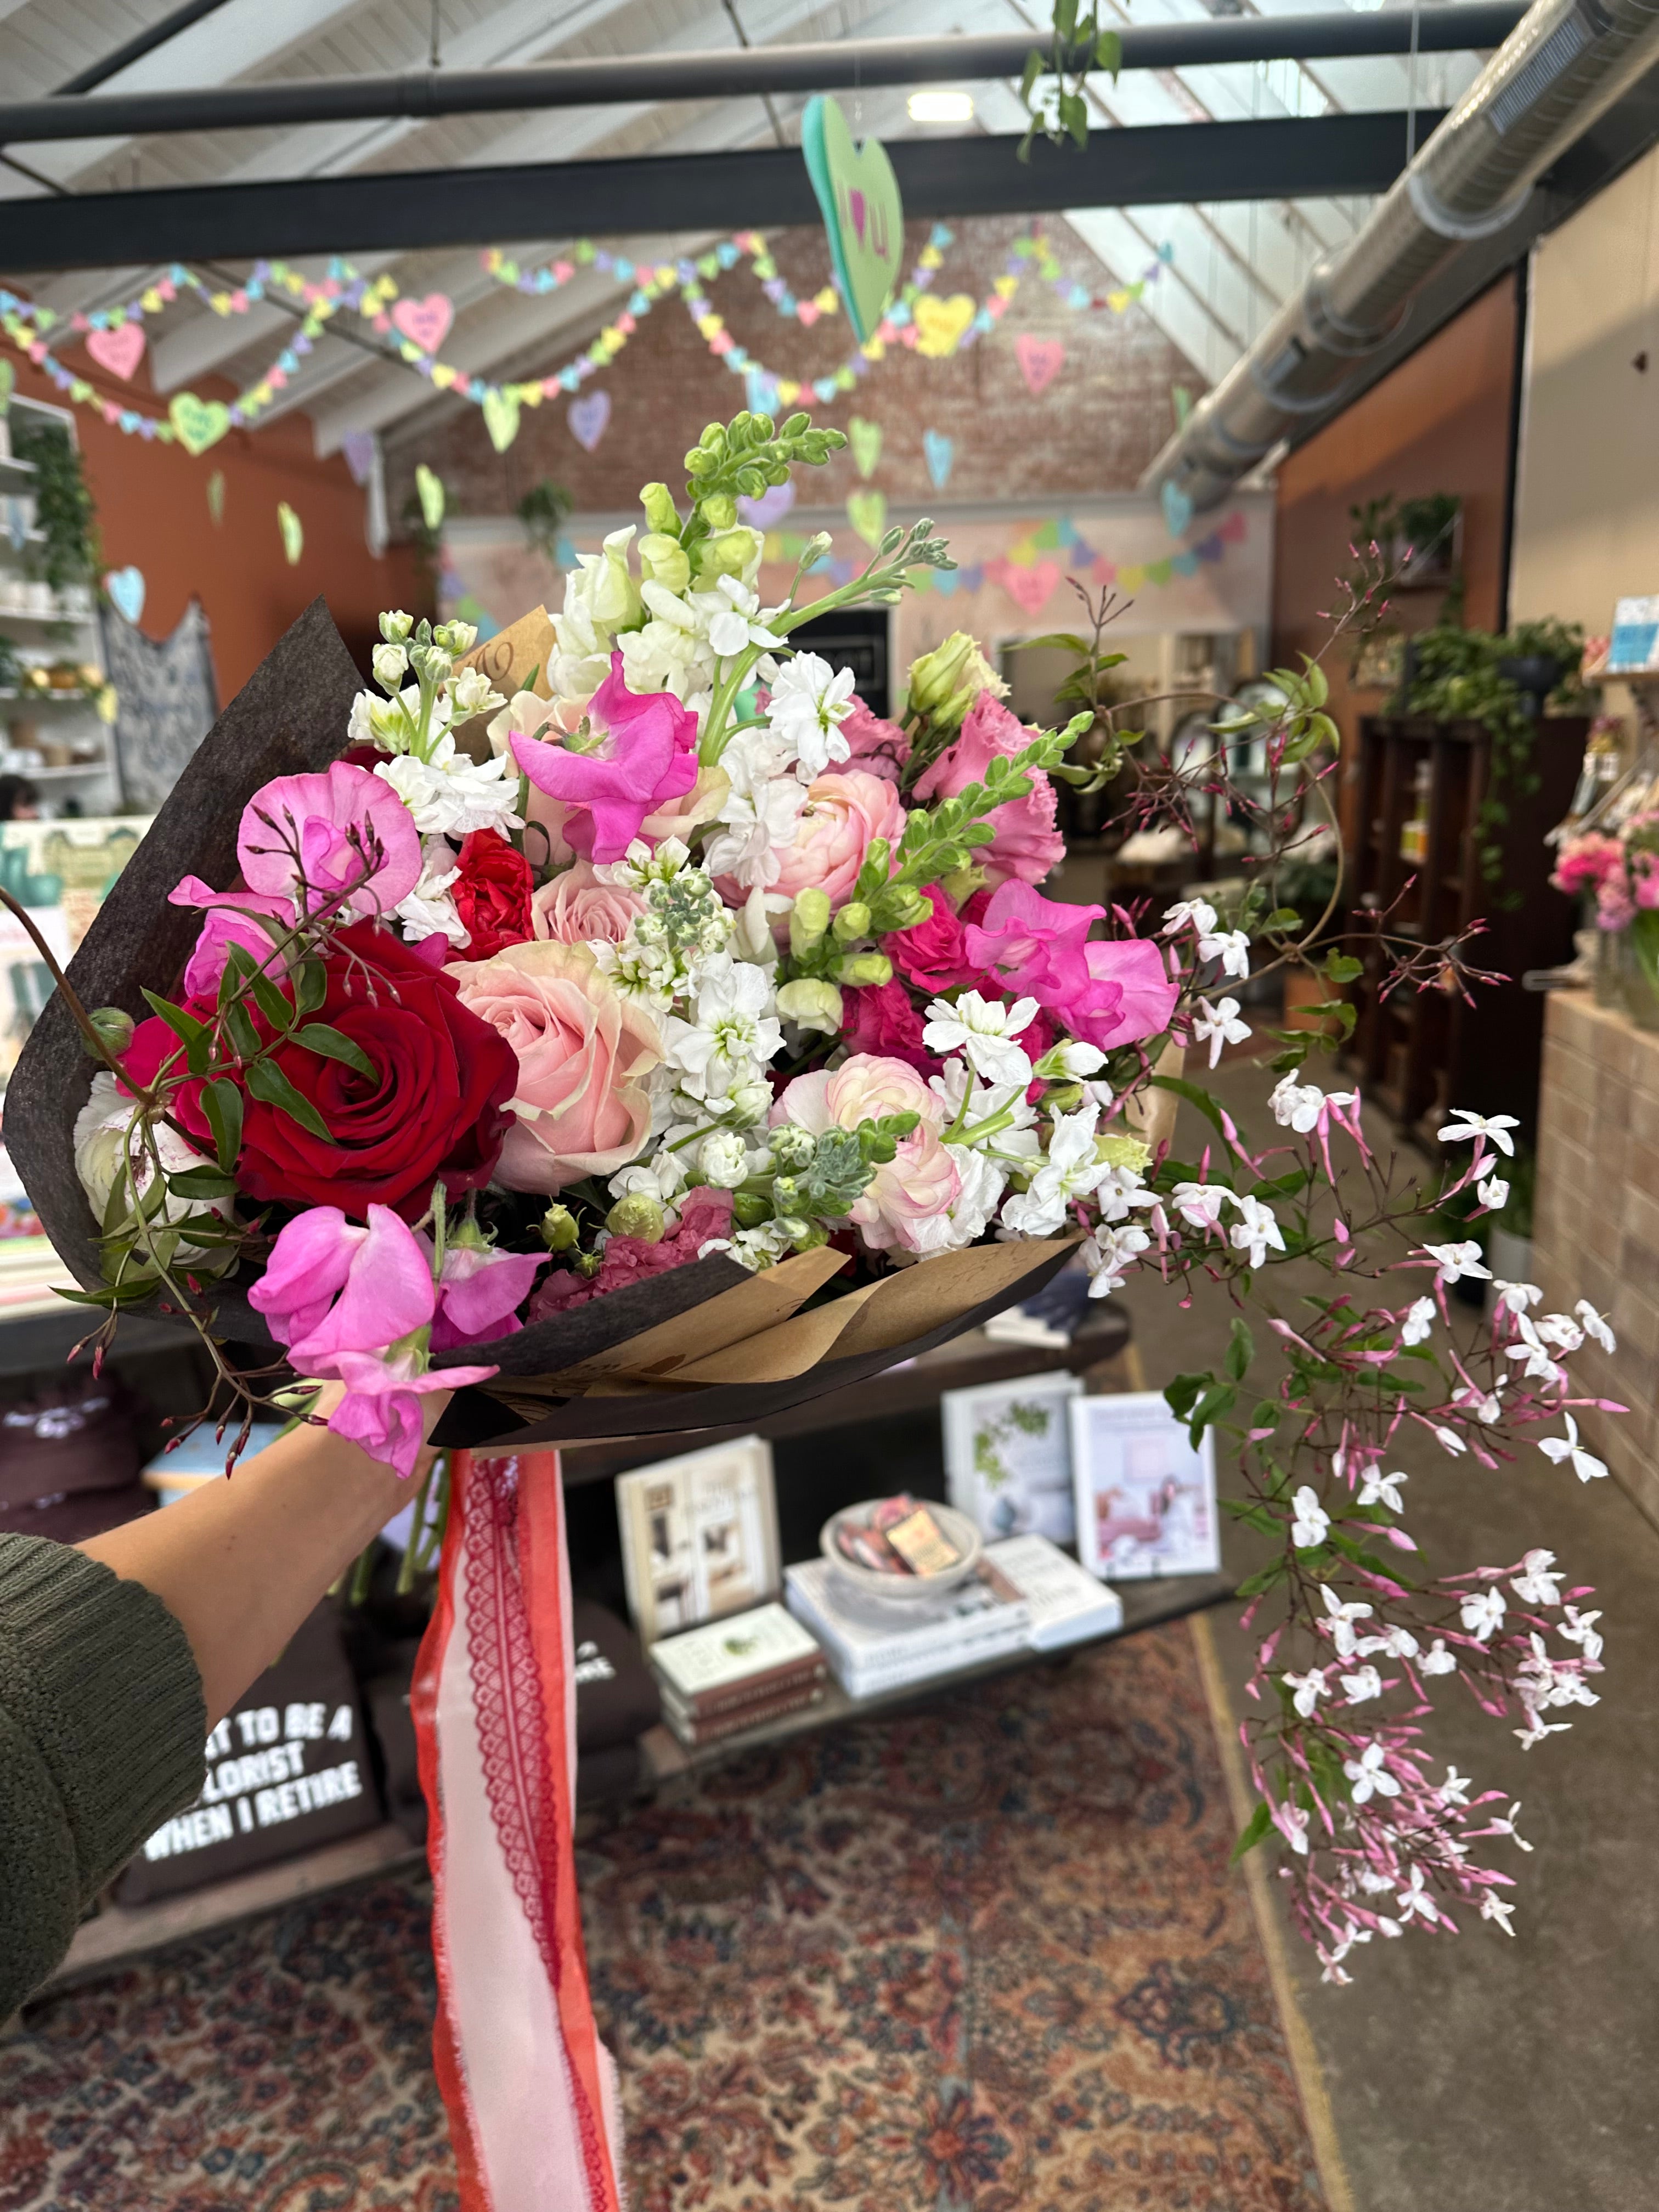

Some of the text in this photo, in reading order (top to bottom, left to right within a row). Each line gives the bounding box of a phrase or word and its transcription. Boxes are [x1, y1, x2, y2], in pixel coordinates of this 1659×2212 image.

[235, 1706, 280, 1747] TO
[284, 1702, 326, 1741] BE
[328, 1703, 353, 1742] A
[202, 1740, 305, 1804] LORIST
[237, 1795, 254, 1833] I
[254, 1760, 363, 1827] RETIRE
